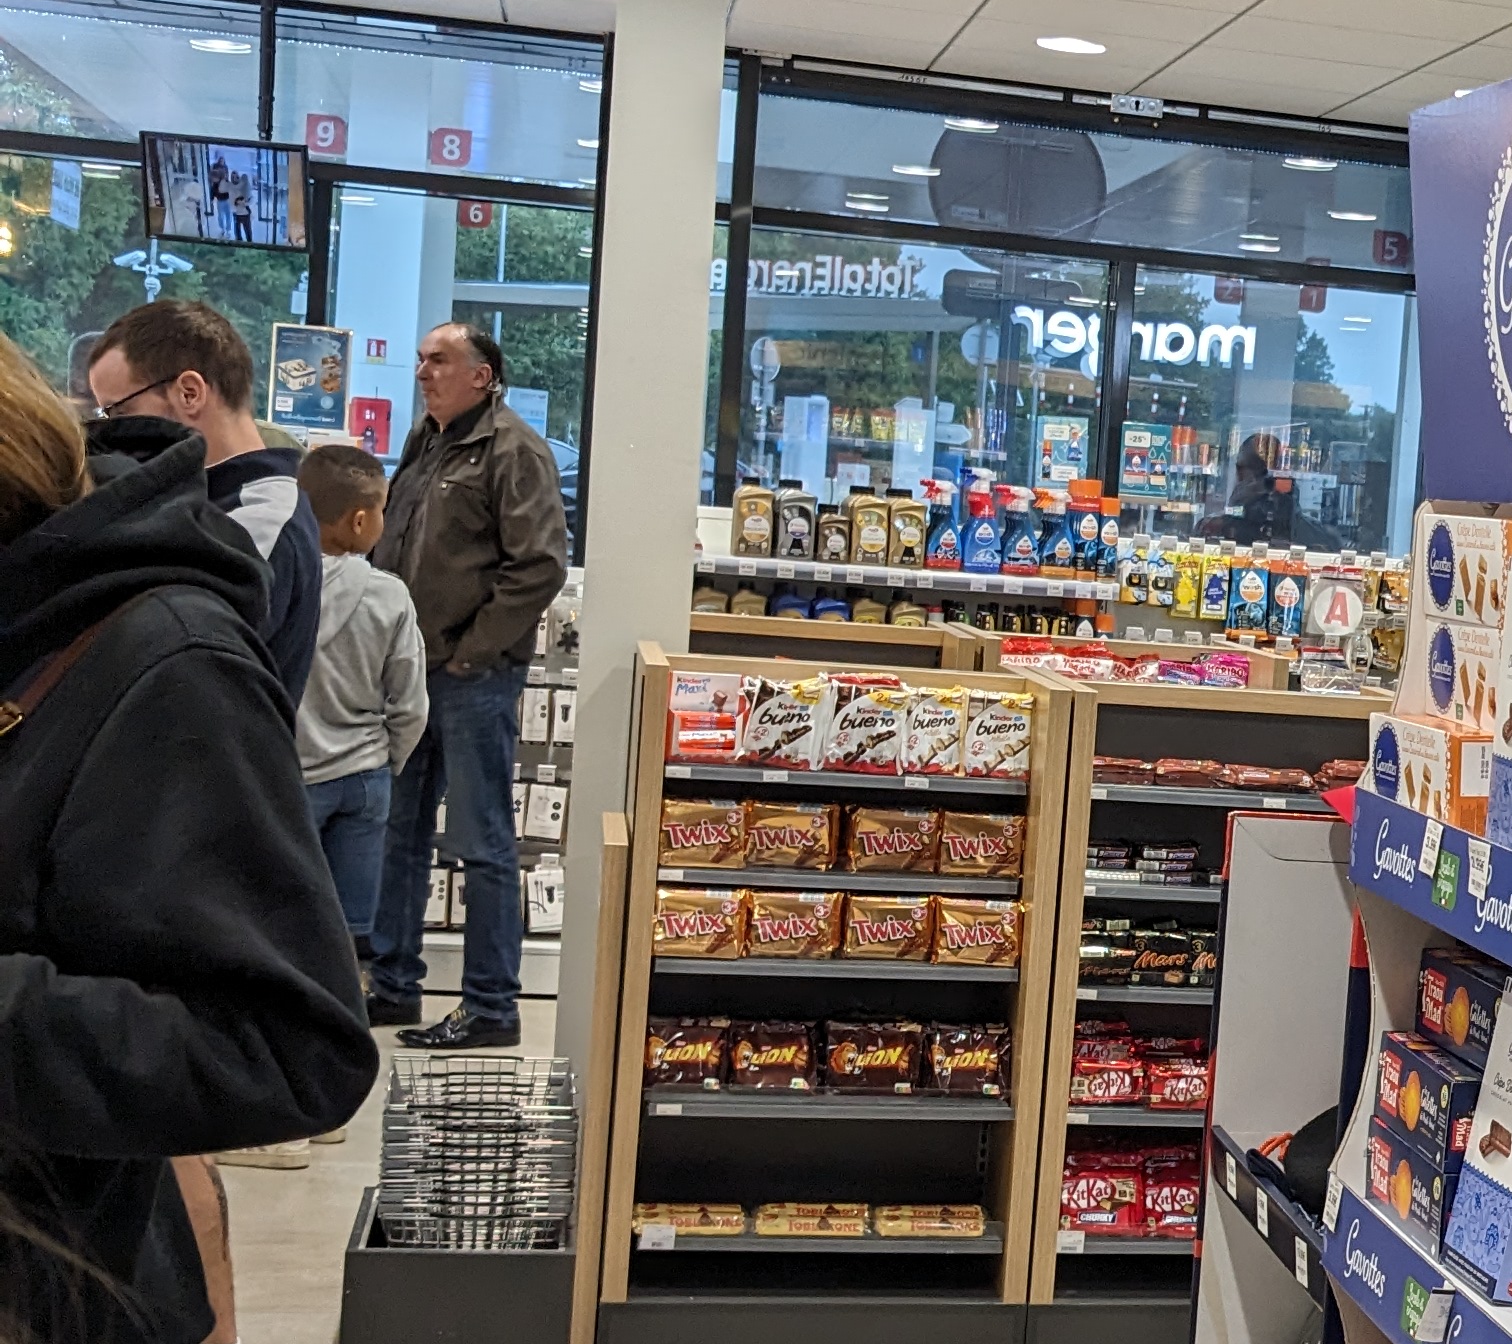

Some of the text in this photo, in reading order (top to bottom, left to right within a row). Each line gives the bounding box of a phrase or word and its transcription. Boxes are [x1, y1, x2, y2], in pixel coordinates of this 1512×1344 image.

[317, 121, 335, 147] 9
[442, 135, 460, 160] 8
[469, 204, 483, 222] 6
[1381, 236, 1398, 262] 5
[1324, 587, 1349, 627] A
[1207, 664, 1245, 679] HARIBO
[840, 715, 895, 730] bueno
[912, 714, 956, 731] bueno
[976, 720, 1026, 737] bueno
[1374, 819, 1416, 883] Gavottes
[1134, 951, 1188, 969] Mars
[1165, 1077, 1204, 1101] KitKat
[1061, 1180, 1112, 1209] KitKat
[1147, 1187, 1198, 1213] KitKat
[1344, 1219, 1386, 1298] Gavottes
